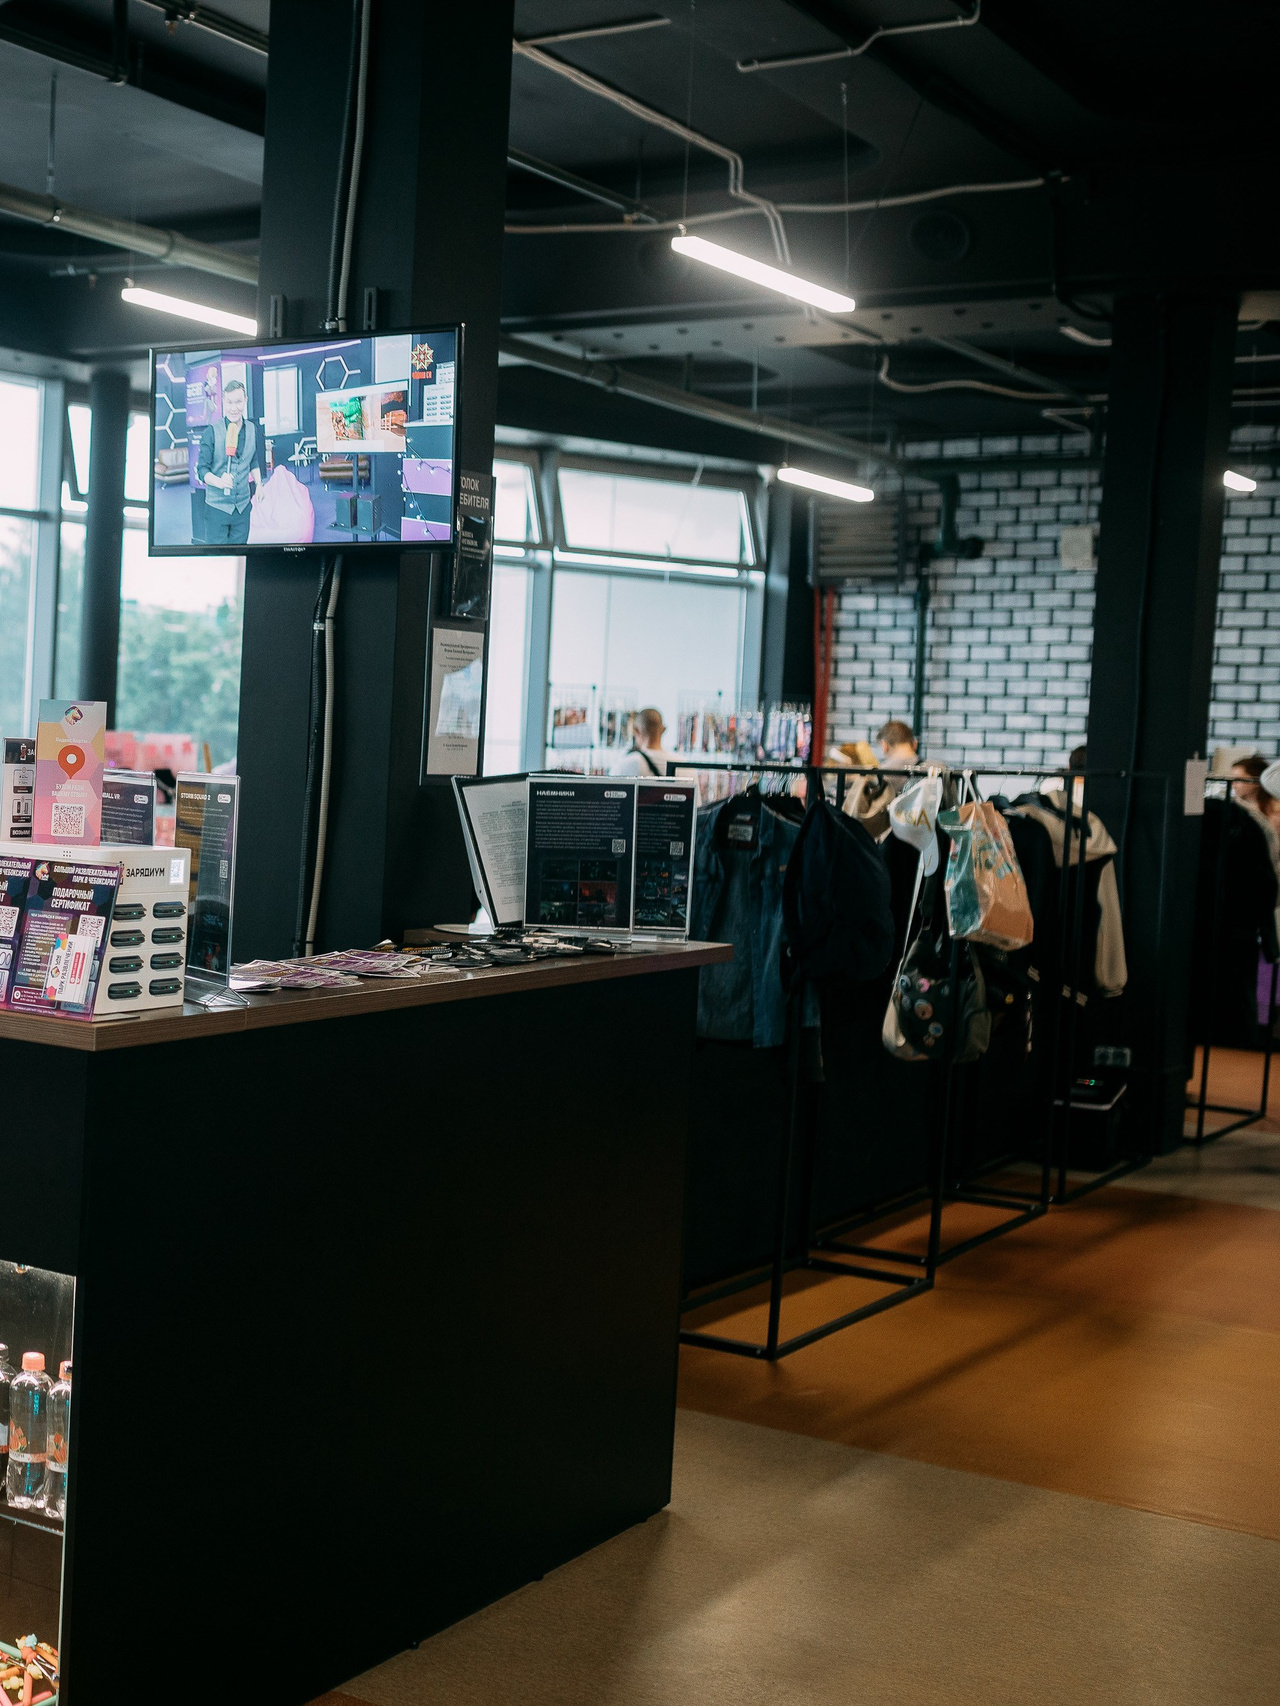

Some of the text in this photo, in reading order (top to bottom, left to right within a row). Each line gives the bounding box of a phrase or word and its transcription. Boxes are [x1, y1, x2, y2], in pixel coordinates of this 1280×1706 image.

[536, 789, 575, 797] НАЁМНИКИ
[3, 869, 30, 878] ЧЕБОКСАРАХ
[126, 867, 165, 877] ЗАРЯДИУМ
[71, 875, 84, 884] ПАРК
[88, 877, 117, 886] ЧЕБОКСАРАХ
[52, 887, 94, 900] ПОДАРОЧНЫЙ
[51, 898, 91, 911] СЕРТИФИКАТ
